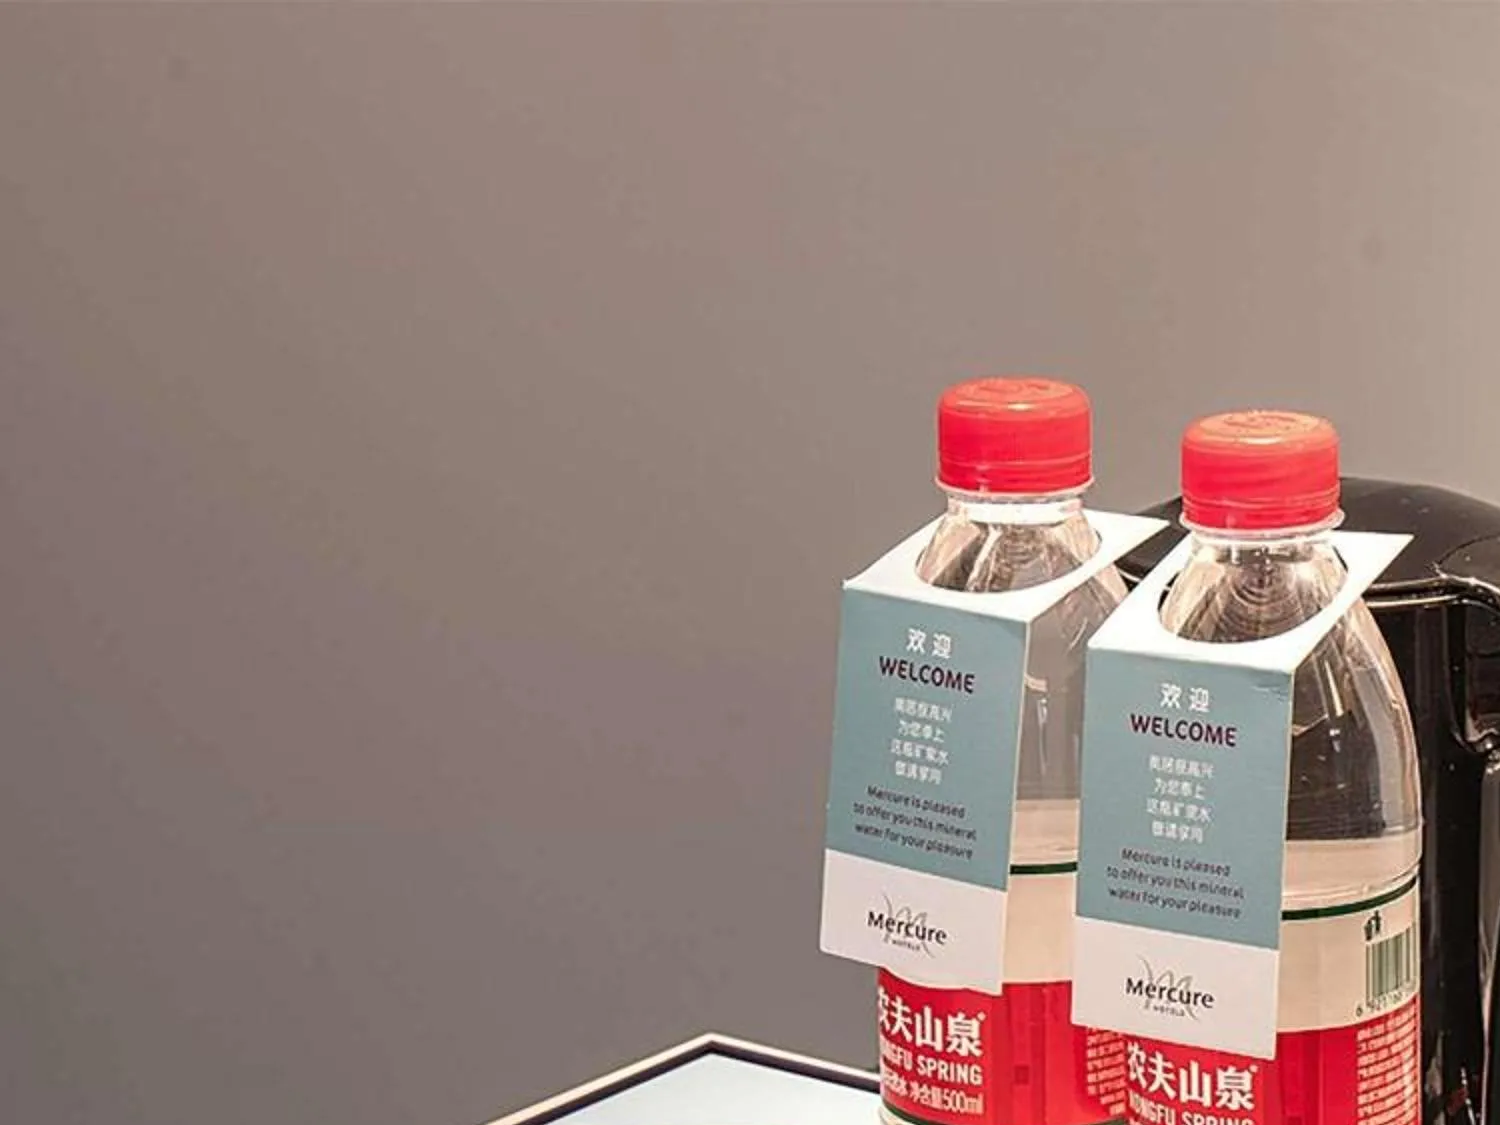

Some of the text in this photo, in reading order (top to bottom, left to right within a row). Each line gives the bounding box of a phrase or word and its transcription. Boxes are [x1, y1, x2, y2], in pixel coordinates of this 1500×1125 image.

[906, 627, 952, 659] 欢迎
[879, 655, 975, 694] WELCOME
[1160, 682, 1210, 713] 欢迎
[1130, 713, 1237, 747] WELCOME
[867, 785, 910, 806] Mercure
[922, 799, 966, 819] pleased
[866, 805, 890, 820] offer
[935, 822, 977, 841] mineral
[926, 839, 974, 860] pleasure
[1121, 848, 1169, 867] Mercure
[1183, 858, 1231, 877] pleased
[1120, 868, 1149, 884] offer
[1199, 881, 1244, 899] mineral
[1188, 899, 1242, 918] pleasure
[867, 911, 948, 946] Mercure
[1126, 977, 1216, 1009] Mercure
[916, 1055, 983, 1086] SPRING
